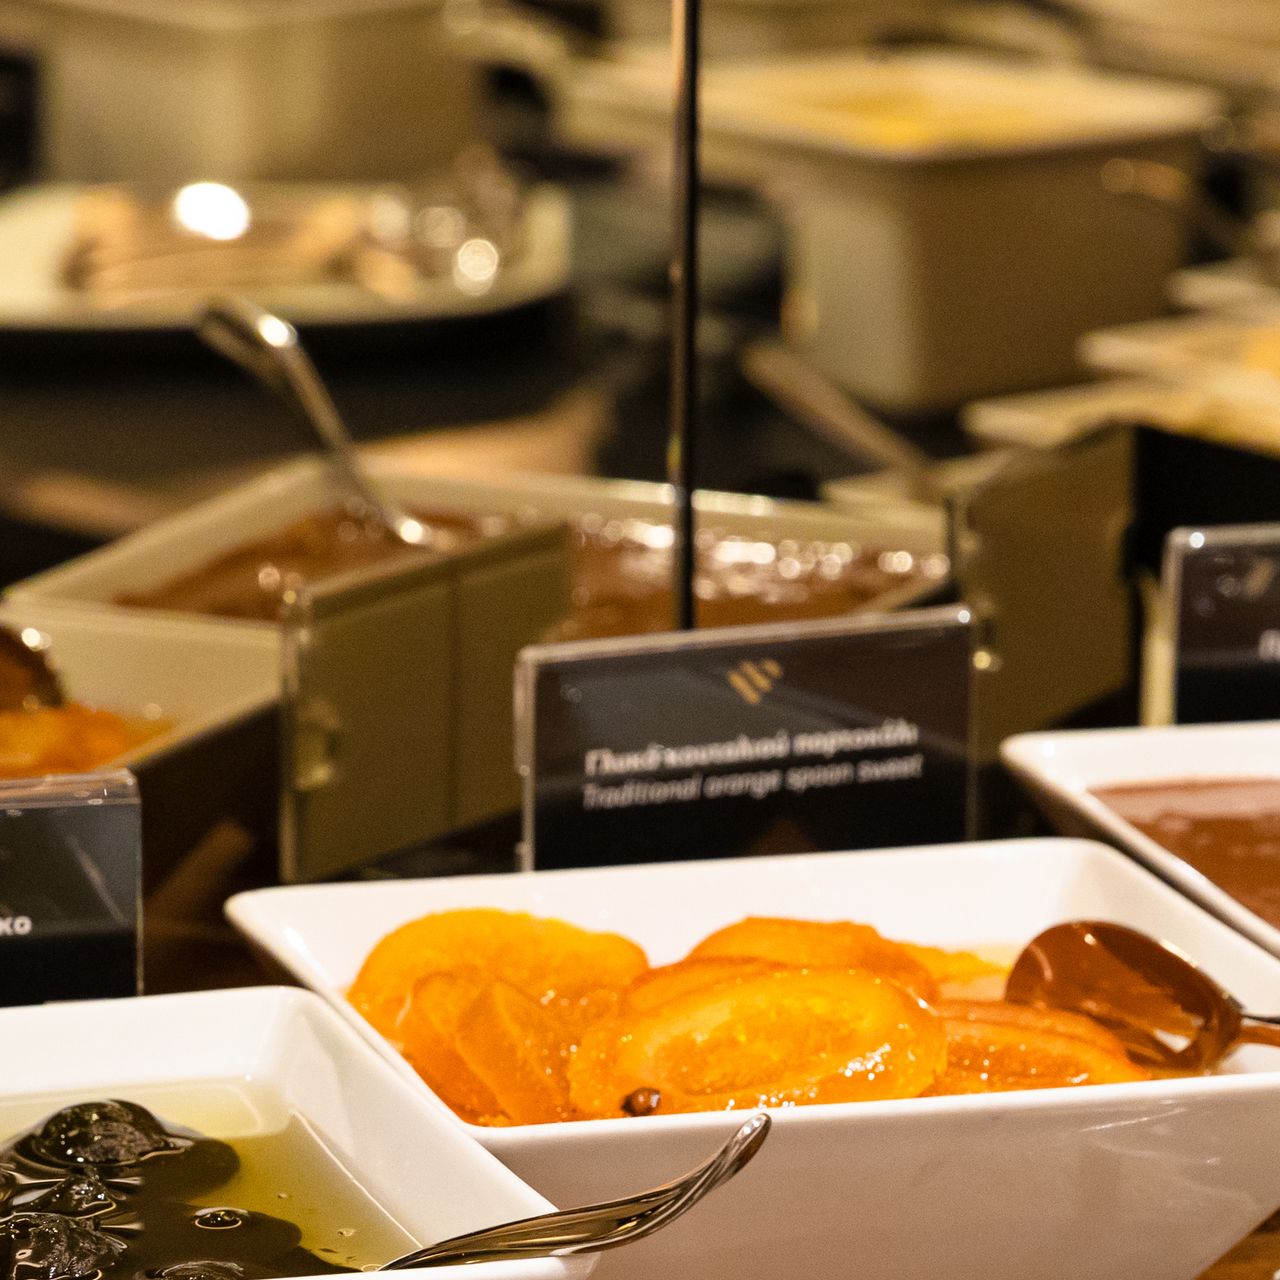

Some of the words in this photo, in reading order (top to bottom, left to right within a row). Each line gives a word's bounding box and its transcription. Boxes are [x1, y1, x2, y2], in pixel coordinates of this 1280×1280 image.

[585, 744, 660, 777] Γλυκό
[663, 731, 789, 768] κουταλιού
[793, 719, 919, 758] πορτοκάλι
[584, 774, 701, 811] Traditional
[704, 769, 783, 800] orange
[786, 761, 854, 793] spoon
[857, 753, 923, 784] sweet
